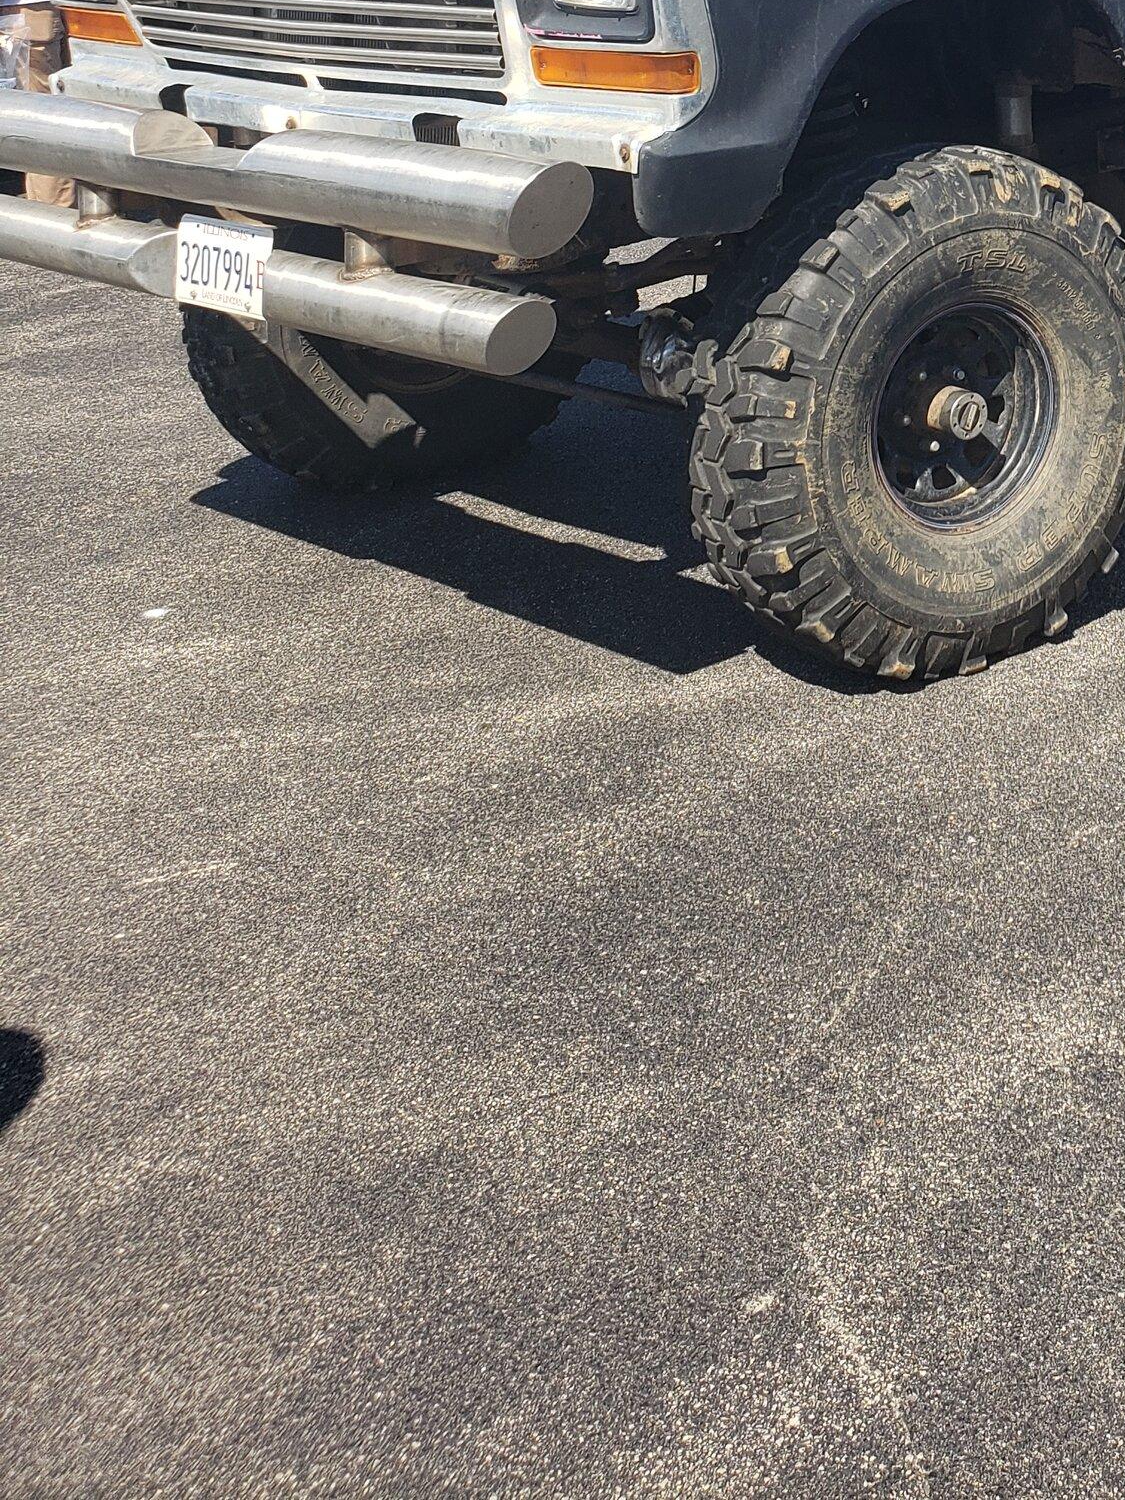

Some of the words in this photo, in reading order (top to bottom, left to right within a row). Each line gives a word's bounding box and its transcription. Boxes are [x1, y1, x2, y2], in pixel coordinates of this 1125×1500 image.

[203, 223, 249, 240] ILLINOIS
[956, 248, 1027, 274] TSL
[840, 460, 996, 593] SWAMPER
[1015, 432, 1108, 573] SUPER
